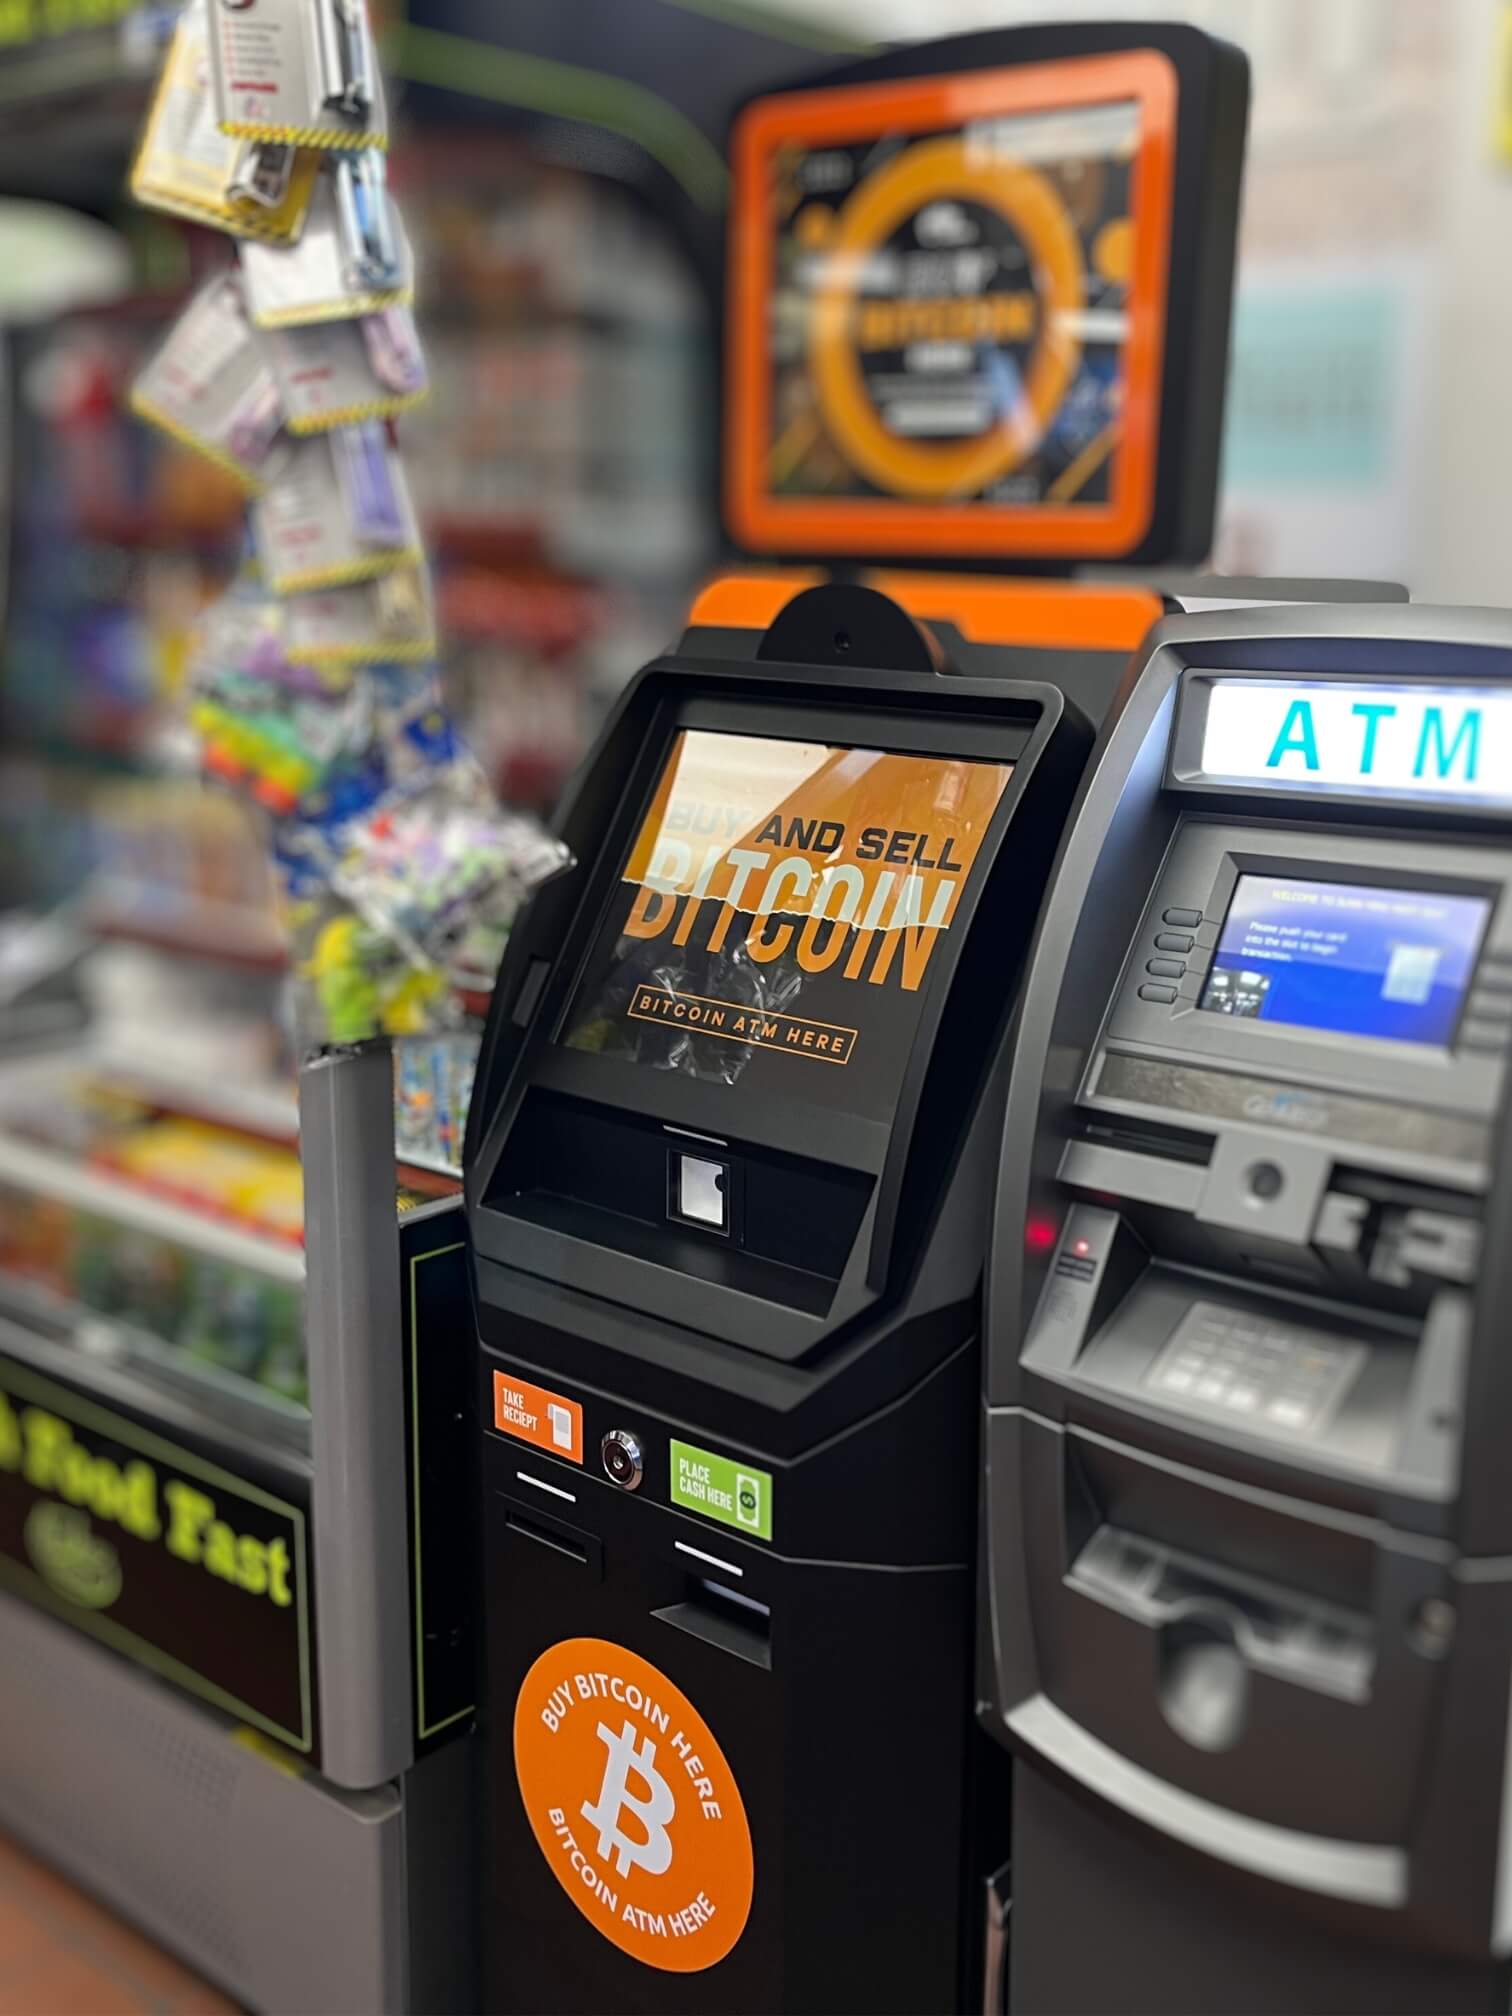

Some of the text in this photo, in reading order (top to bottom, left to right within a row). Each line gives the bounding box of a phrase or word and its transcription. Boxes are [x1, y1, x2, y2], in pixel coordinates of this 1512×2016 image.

[1266, 699, 1483, 782] ATM
[666, 802, 962, 873] BUY AND SELL
[622, 836, 956, 992] BITCOIN
[639, 995, 845, 1053] BITCOIN ATM HERE
[503, 1387, 525, 1410] TAKE
[503, 1404, 538, 1432] RECIEPT
[20, 1407, 161, 1541] Food
[165, 1479, 292, 1606] Fast
[680, 1457, 710, 1485] PLACE
[680, 1475, 733, 1512] CASH HERE
[541, 1672, 722, 1820] BUY BITCOIN HERE
[548, 1807, 716, 1937] BITCOIN ATM HERE
